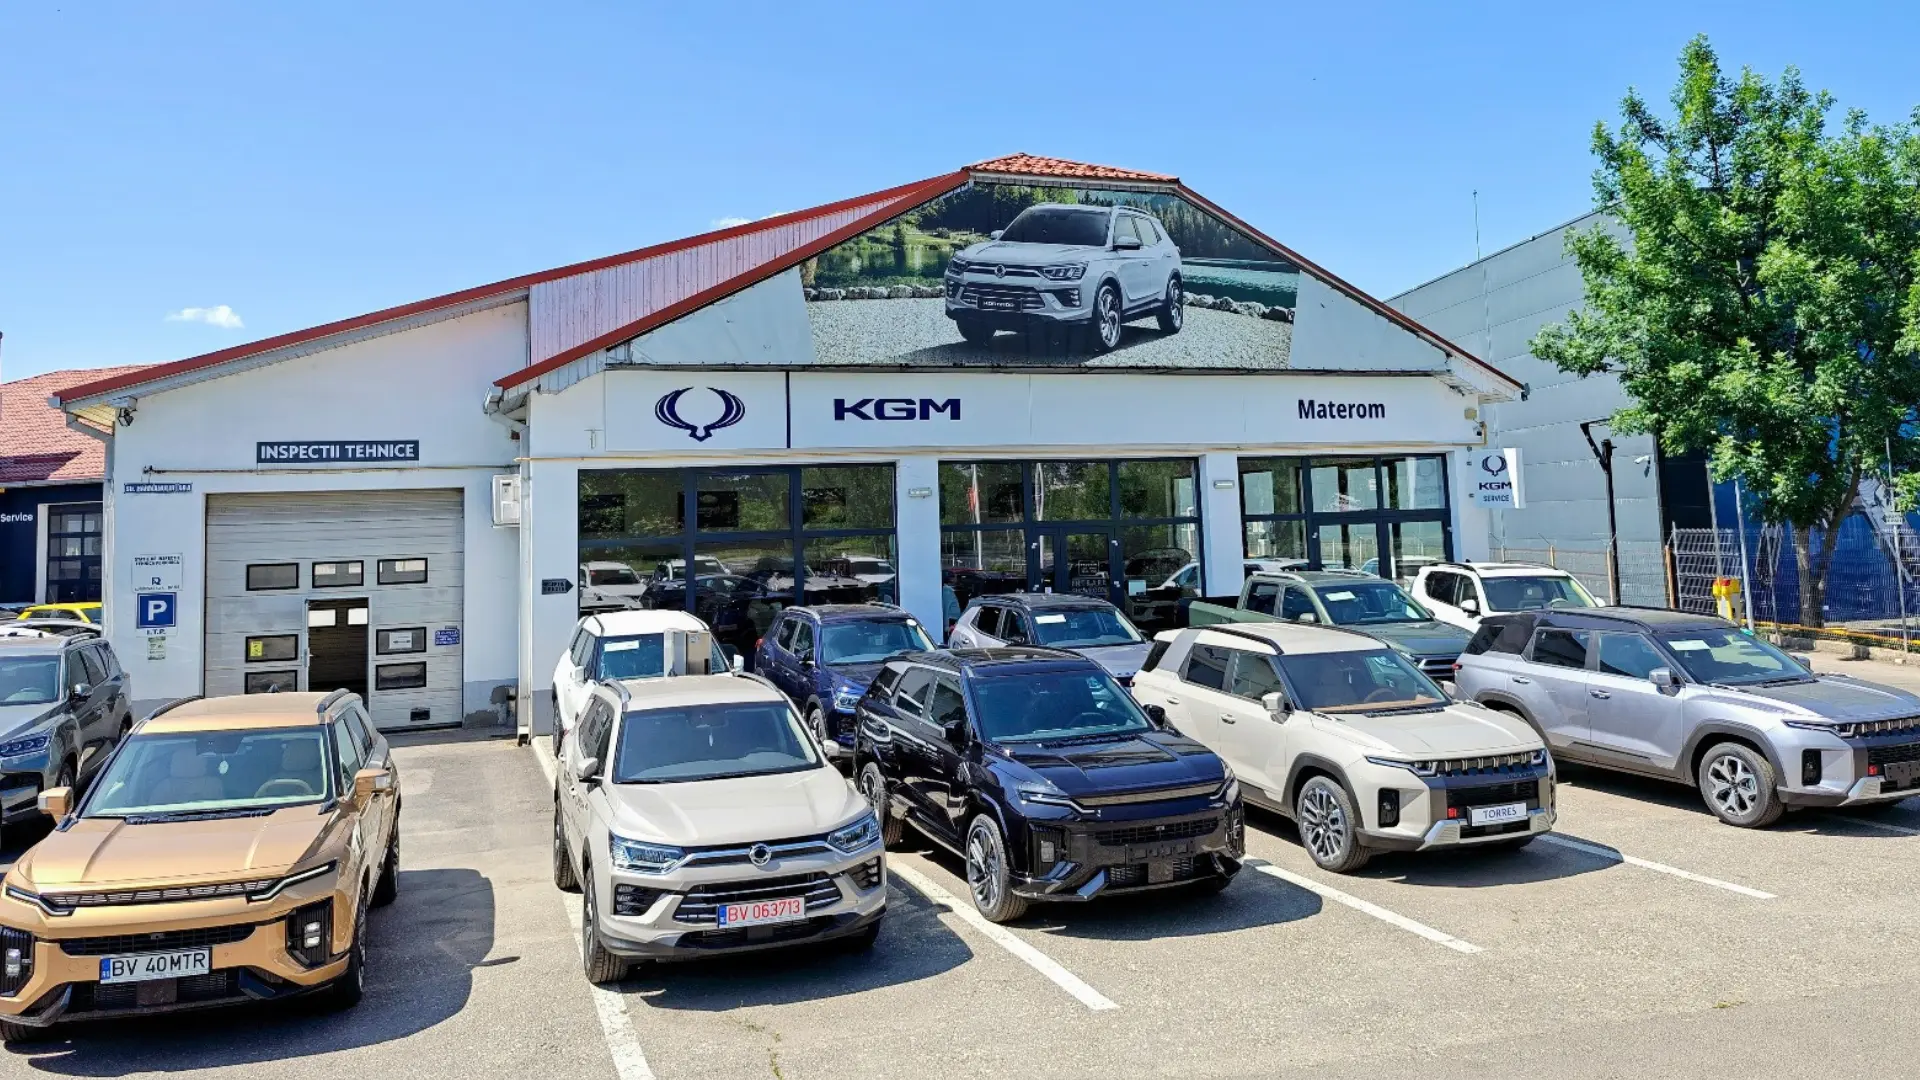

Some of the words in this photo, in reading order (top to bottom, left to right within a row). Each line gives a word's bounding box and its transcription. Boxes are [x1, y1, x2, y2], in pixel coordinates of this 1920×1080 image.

[833, 398, 961, 421] KGM
[1298, 399, 1385, 419] Materom
[260, 444, 340, 459] INSPECTII
[345, 443, 415, 458] TEHNICE
[1478, 481, 1512, 491] KGM
[1483, 494, 1510, 502] SERVICE
[0, 511, 34, 523] Service
[148, 600, 168, 621] P
[1483, 806, 1517, 819] TORRES
[728, 905, 749, 922] BV
[753, 899, 801, 919] 063713
[112, 958, 138, 977] BV
